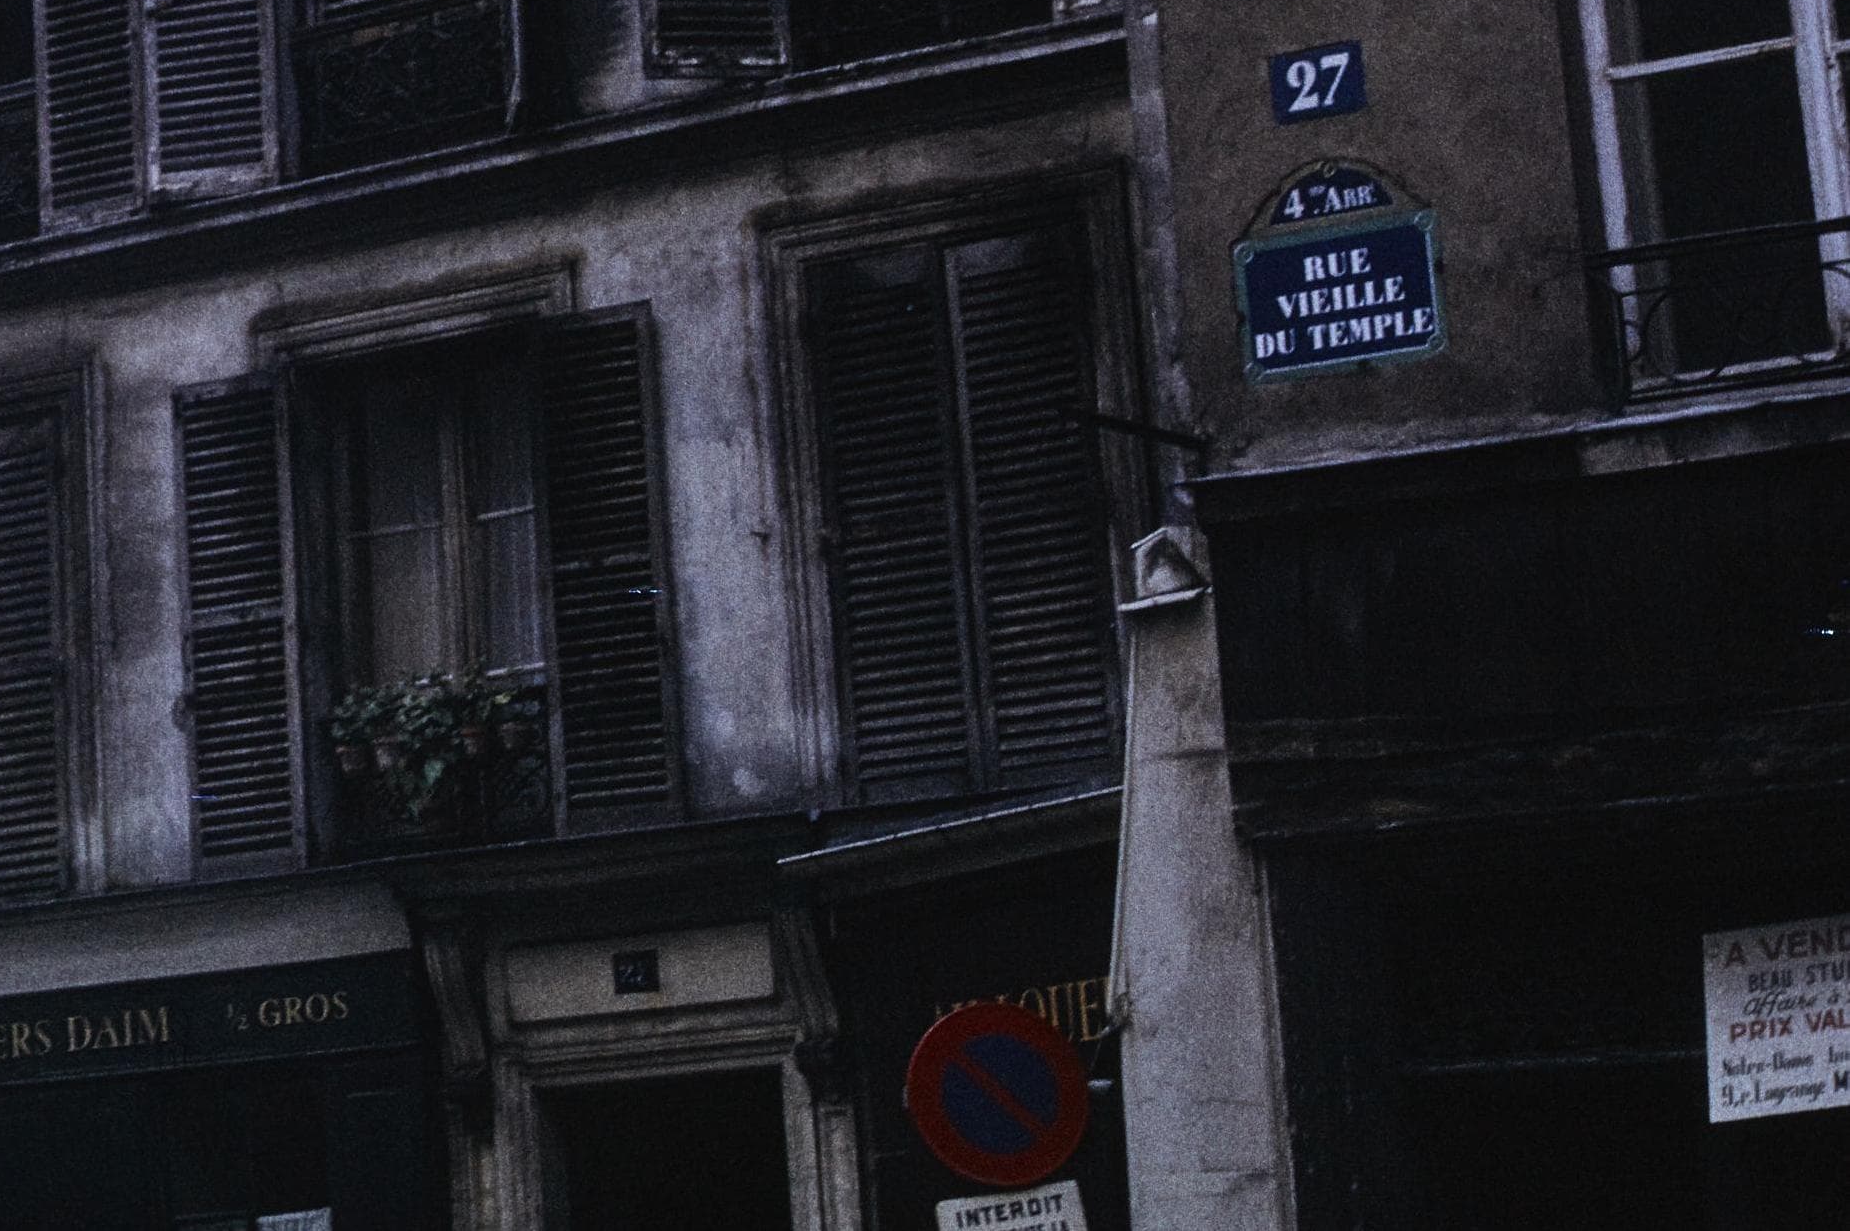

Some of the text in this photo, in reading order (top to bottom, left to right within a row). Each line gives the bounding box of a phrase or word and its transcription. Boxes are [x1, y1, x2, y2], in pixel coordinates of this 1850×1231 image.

[1286, 52, 1350, 112] 27
[1303, 247, 1372, 282] RUE
[1276, 275, 1407, 319] VIEILLE
[1255, 306, 1435, 359] DU TEMPLE
[1724, 941, 1747, 968] A
[1748, 970, 1793, 993] BEAU
[66, 1006, 172, 1052] DAIM
[258, 991, 349, 1028] GROS
[1730, 1016, 1793, 1044] PRIX
[955, 1194, 1063, 1229] INTERDIT
